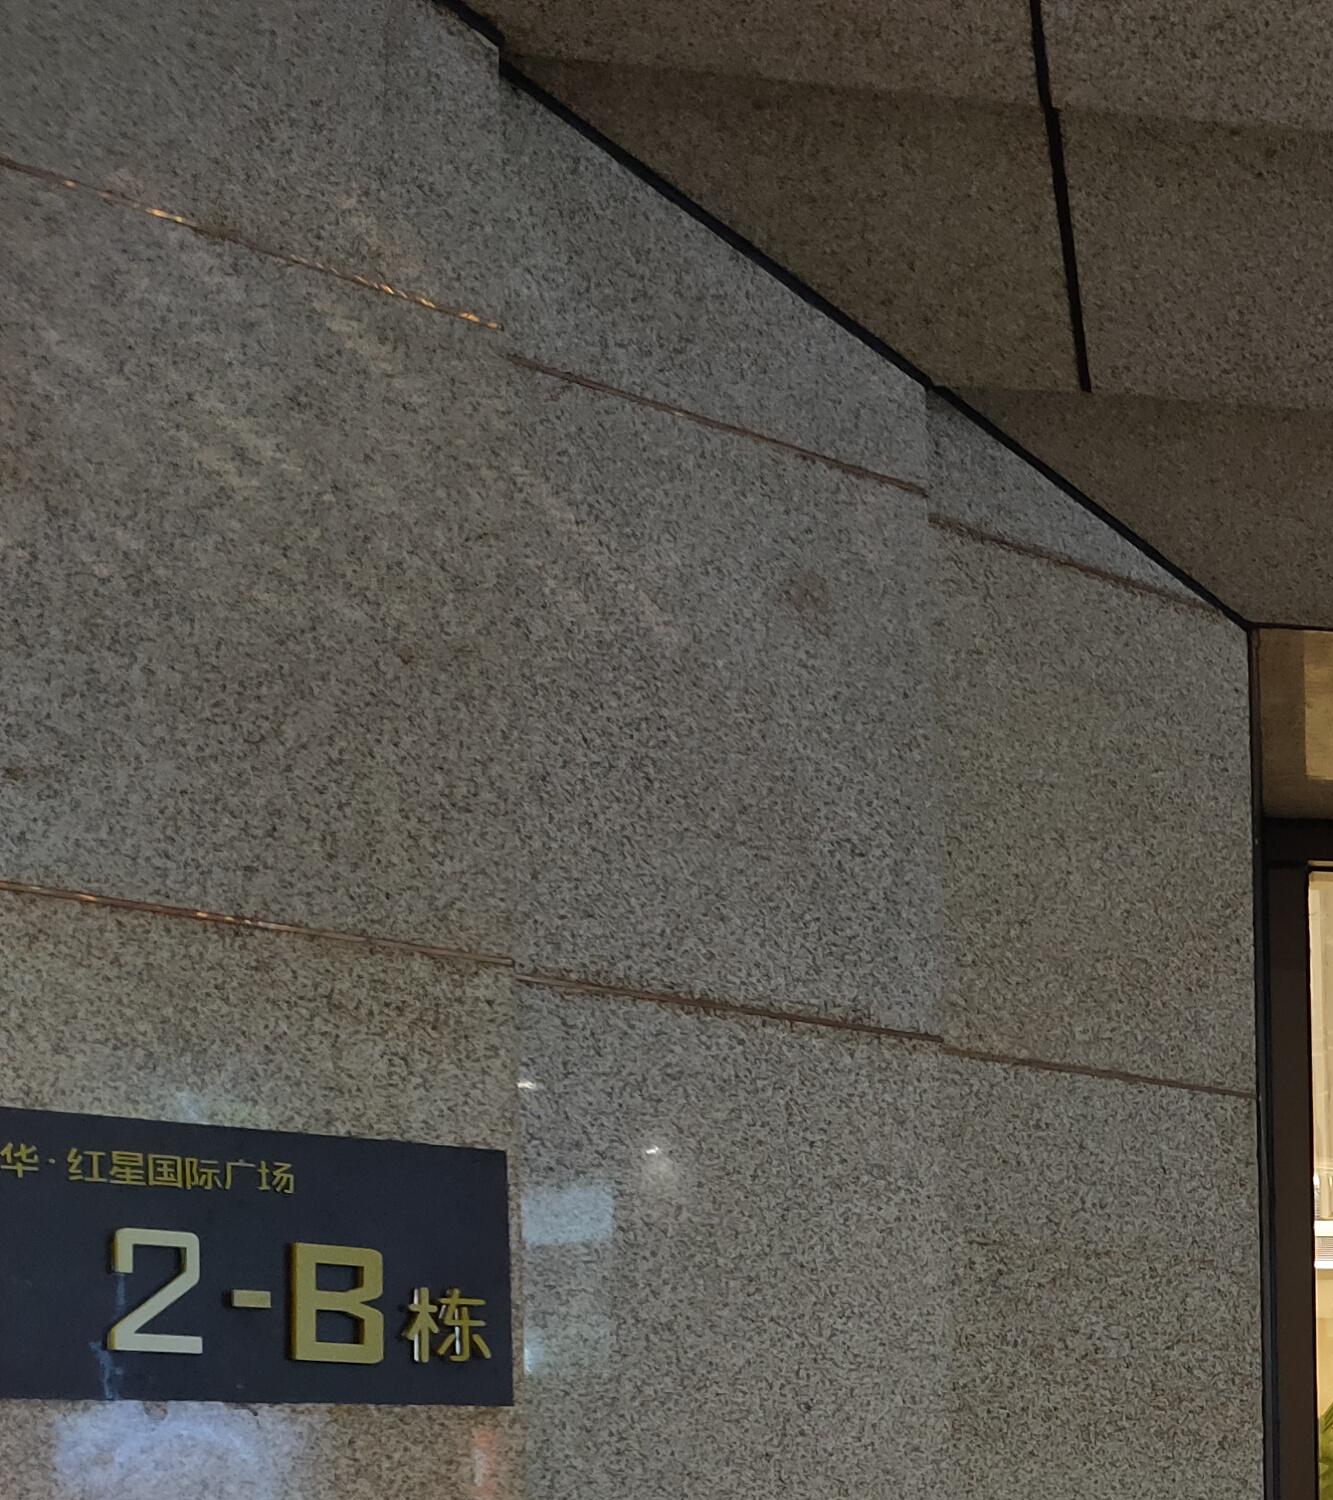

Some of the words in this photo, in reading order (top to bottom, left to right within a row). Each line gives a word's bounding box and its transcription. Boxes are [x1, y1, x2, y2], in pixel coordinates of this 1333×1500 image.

[0, 1143, 295, 1194] 华·红星国际广场
